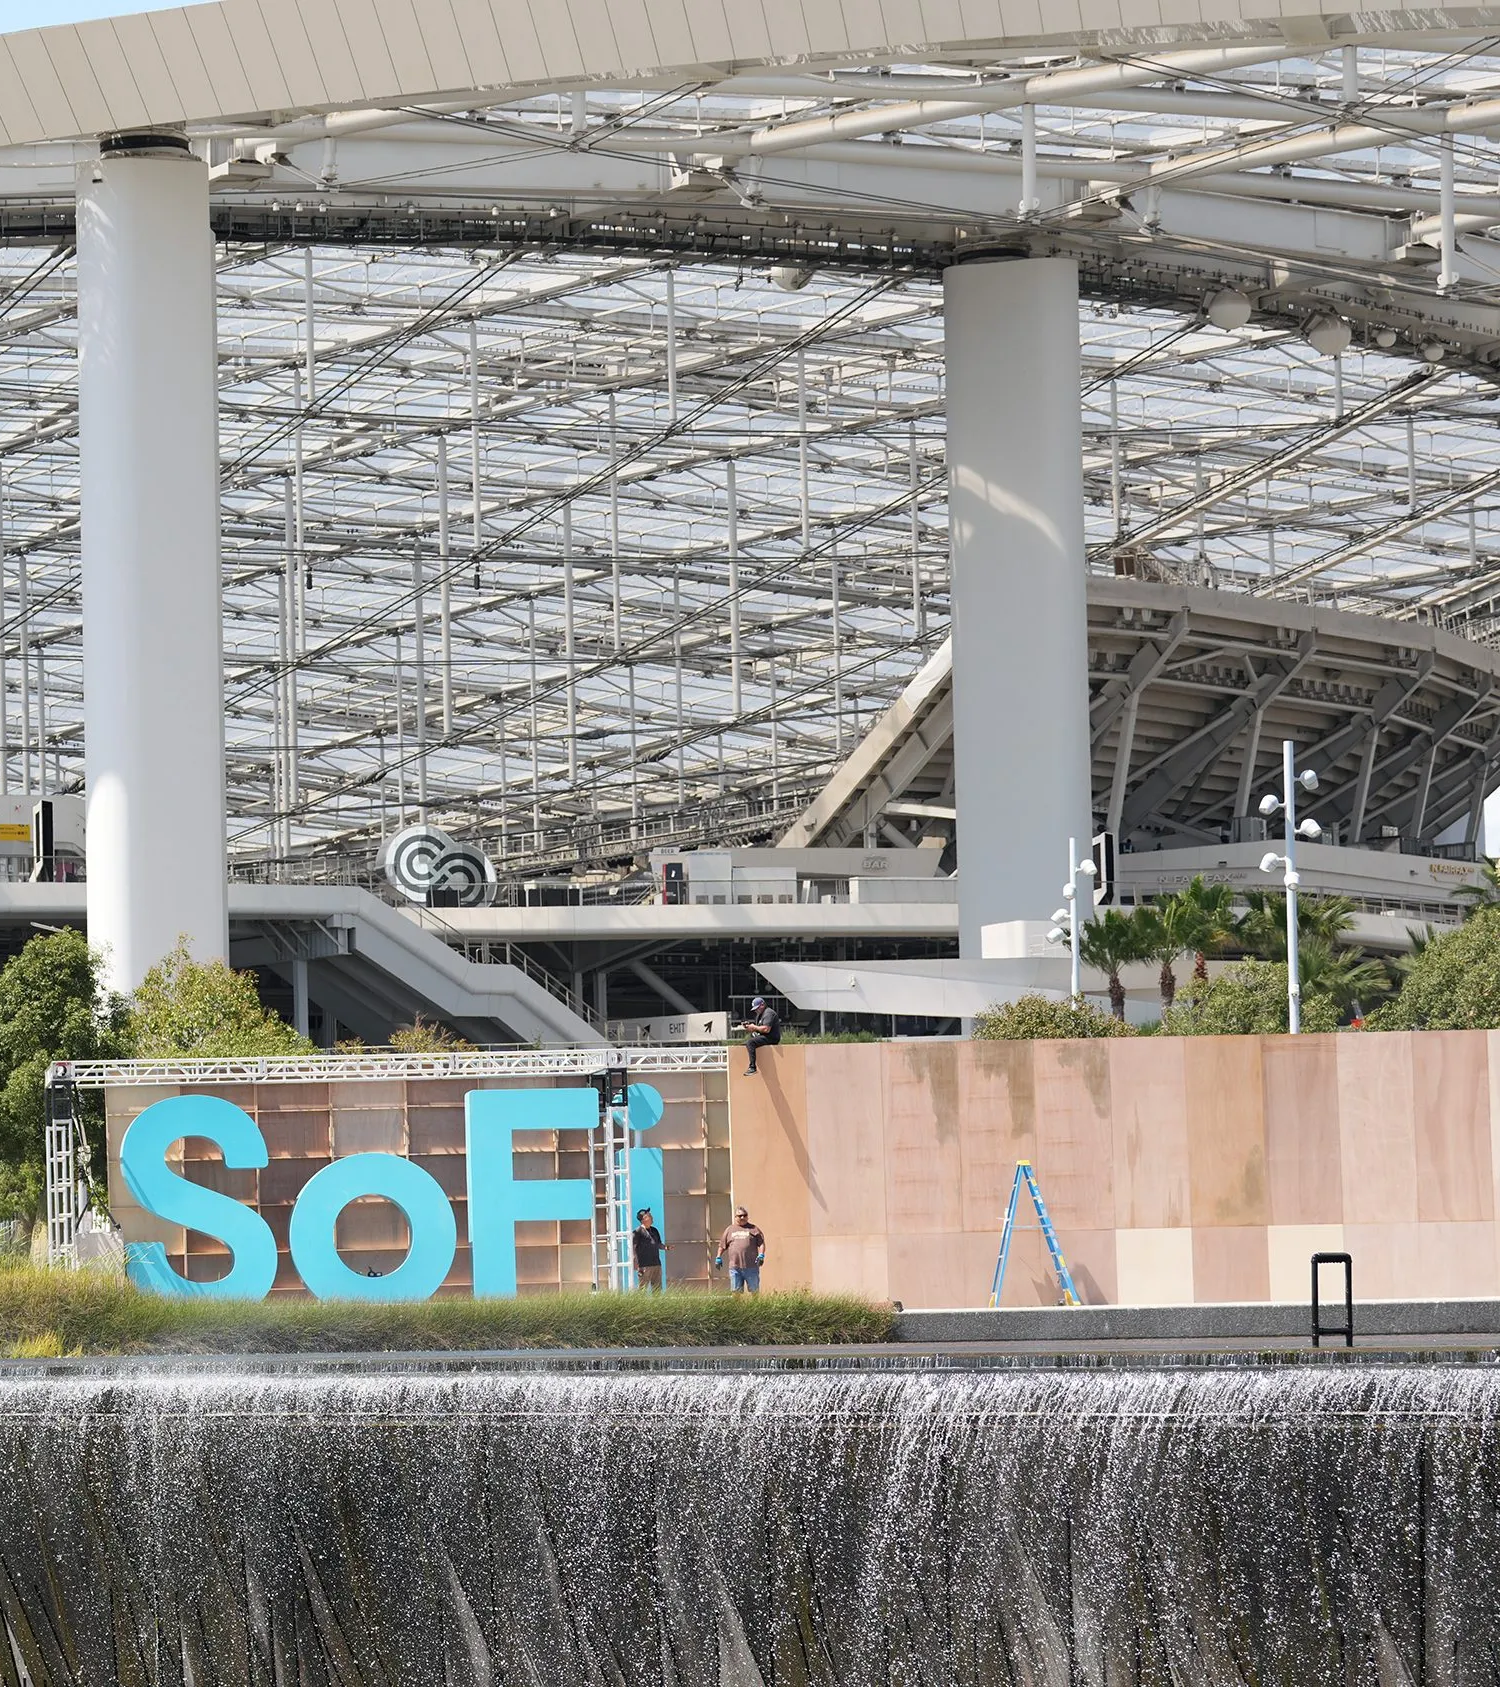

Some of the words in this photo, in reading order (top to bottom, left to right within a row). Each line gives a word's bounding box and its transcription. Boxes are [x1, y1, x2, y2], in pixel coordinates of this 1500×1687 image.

[862, 860, 889, 870] BAR
[1174, 873, 1234, 883] FAFAX
[669, 1022, 686, 1034] EXIT
[120, 1083, 665, 1300] SoFi
